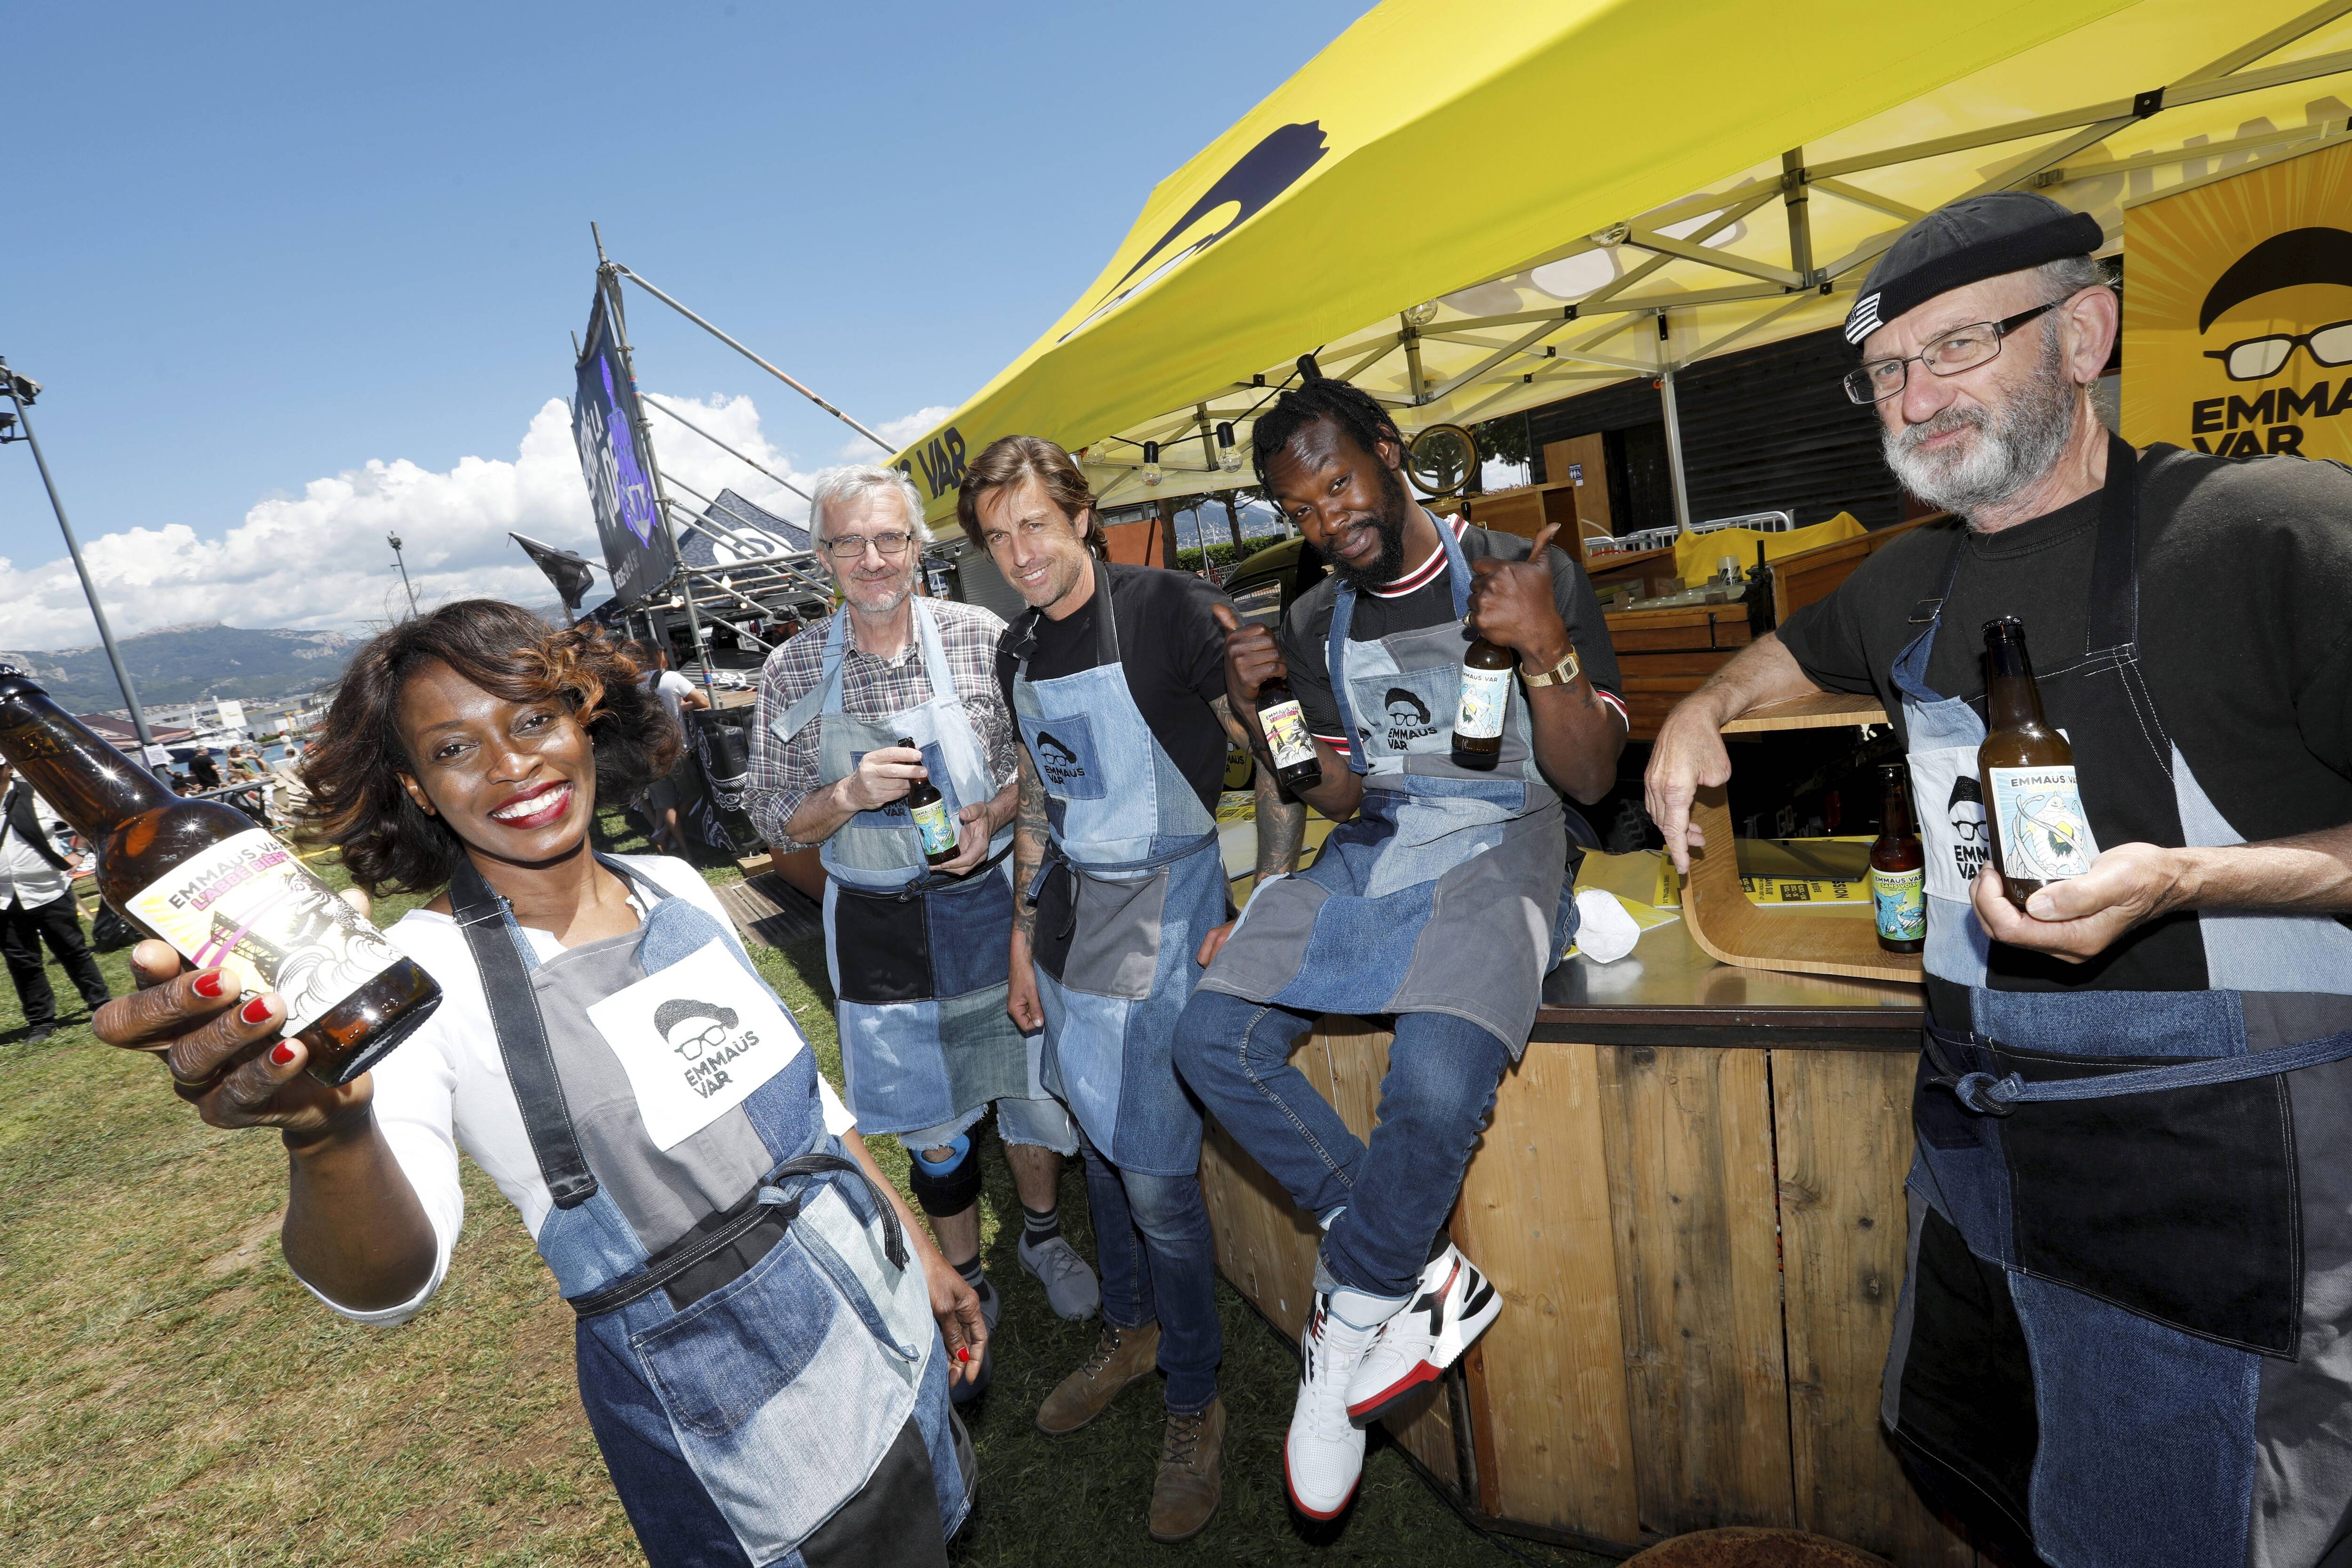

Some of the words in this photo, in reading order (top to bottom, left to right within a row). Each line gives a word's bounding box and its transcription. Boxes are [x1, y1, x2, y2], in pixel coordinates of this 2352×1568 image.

[2192, 377, 2352, 435] EMMA
[2191, 425, 2306, 458] VAR
[916, 427, 968, 500] VAR
[1388, 739, 1409, 751] VAR
[1047, 774, 1065, 785] VAR
[2011, 775, 2066, 787] EMMAÜS
[883, 807, 906, 816] VAR
[1954, 845, 1989, 863] EMM
[168, 849, 256, 909] EMMAÜS
[1956, 862, 1983, 880] VA
[191, 865, 254, 911] L'ABBÉ
[1832, 881, 1849, 899] SSION
[684, 1031, 759, 1087] EMMAÜS
[693, 1071, 733, 1098] VAR
